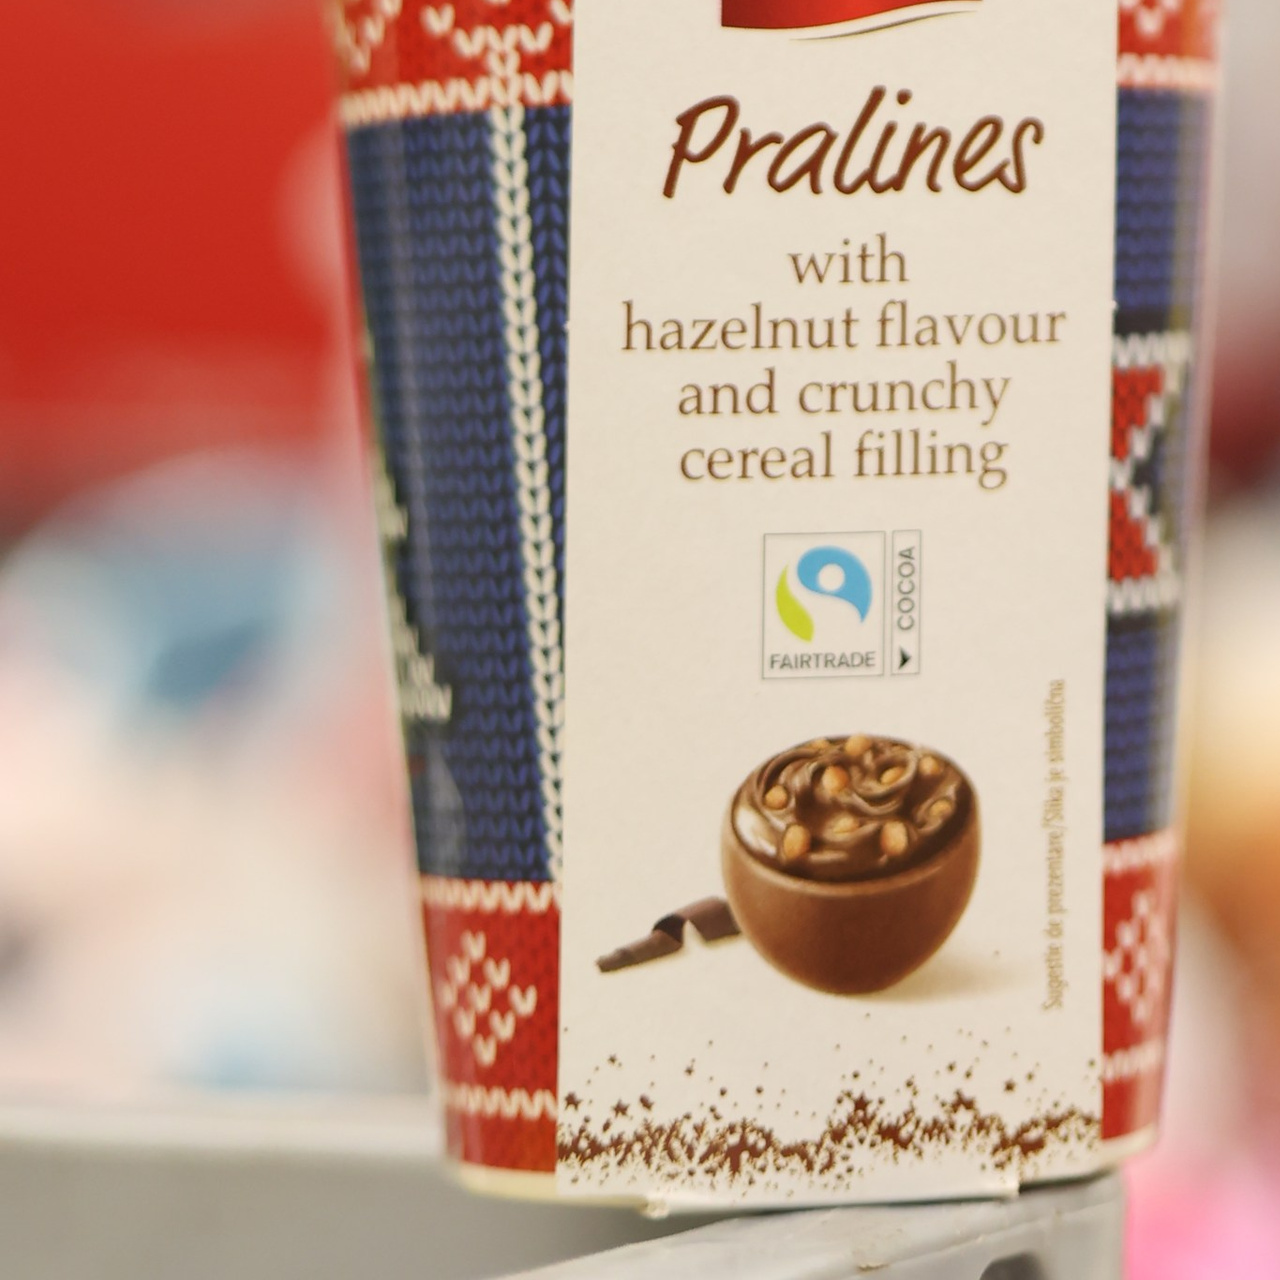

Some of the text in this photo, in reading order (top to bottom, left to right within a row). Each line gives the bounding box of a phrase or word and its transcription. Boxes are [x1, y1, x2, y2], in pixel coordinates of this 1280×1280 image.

[663, 84, 1044, 199] Pralines
[788, 232, 910, 284] with
[621, 299, 1067, 351] hazelnut flavour
[679, 359, 1012, 426] and crunchy
[680, 429, 1009, 490] cereal filling
[897, 546, 915, 630] COCOA
[769, 651, 876, 670] FAIRTRADE
[1044, 768, 1069, 782] je
[1043, 920, 1063, 938] de
